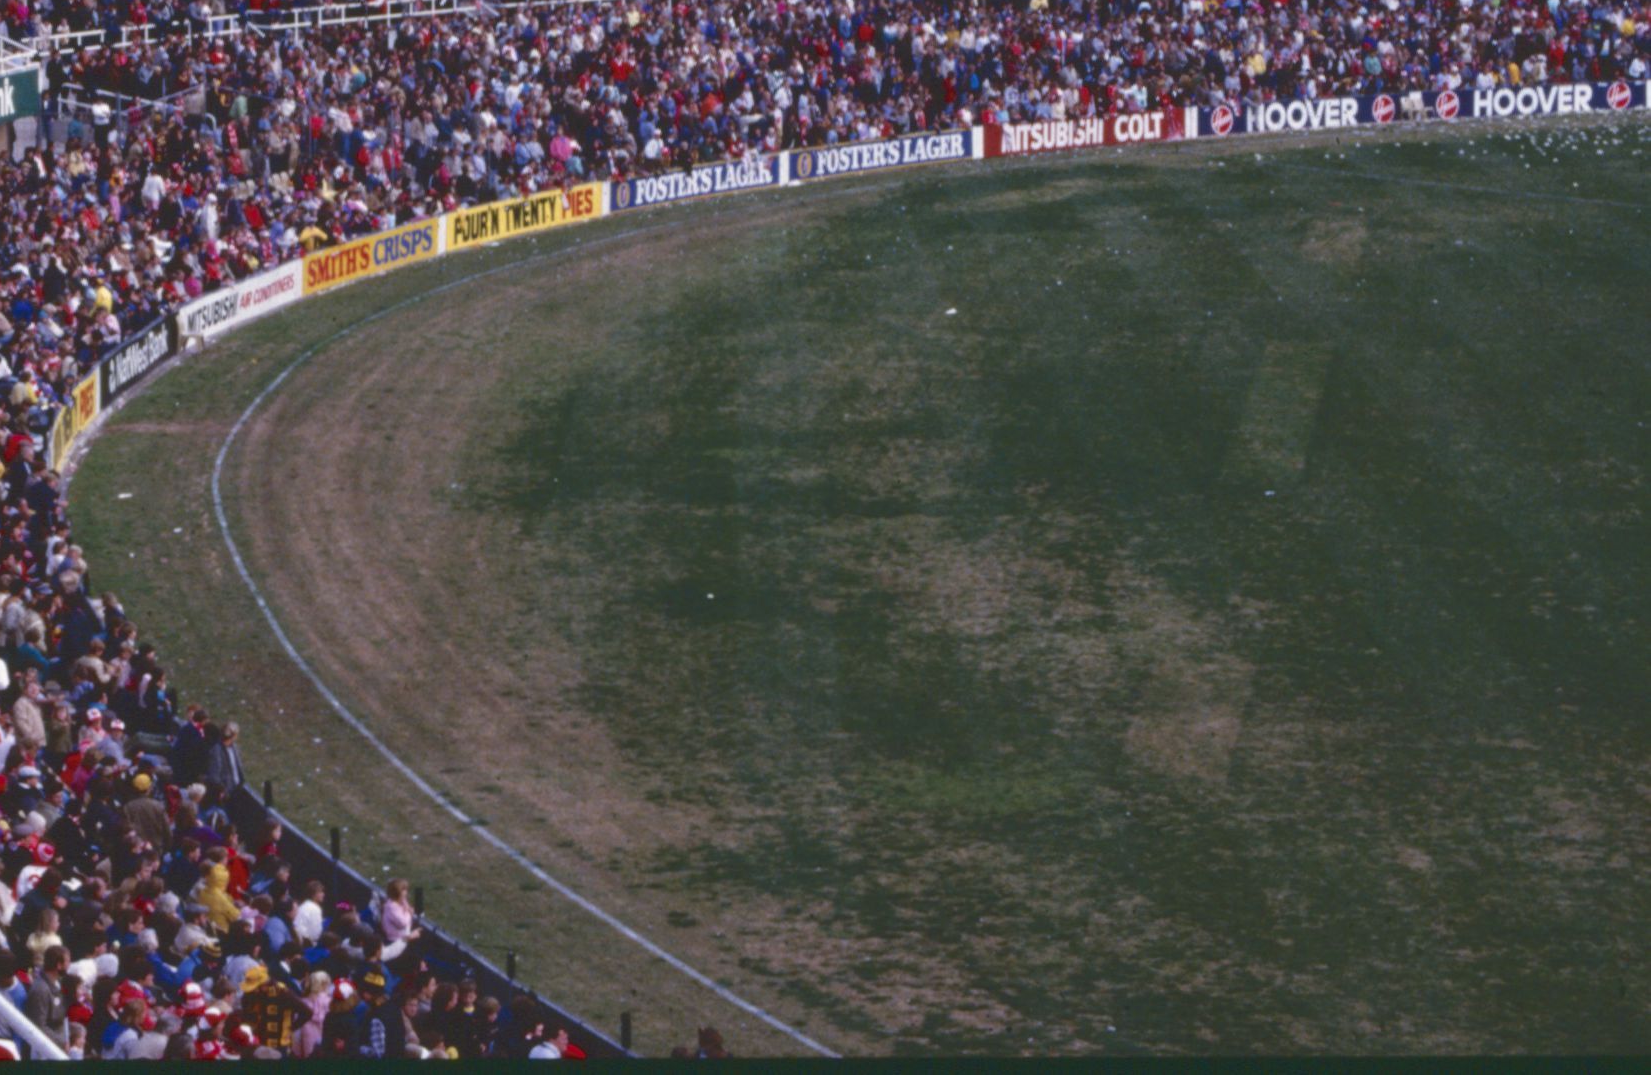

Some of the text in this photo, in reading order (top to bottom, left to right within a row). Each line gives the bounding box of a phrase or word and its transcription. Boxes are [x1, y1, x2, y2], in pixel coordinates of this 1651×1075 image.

[1246, 97, 1359, 132] HOOVER
[1473, 83, 1593, 118] HOOVER
[1001, 111, 1164, 154] MITSUBISHI COLT
[816, 132, 965, 176] FOSTER'S LAGER
[505, 196, 556, 232] TWENTY
[307, 225, 433, 287] SMITH'S CRISPS
